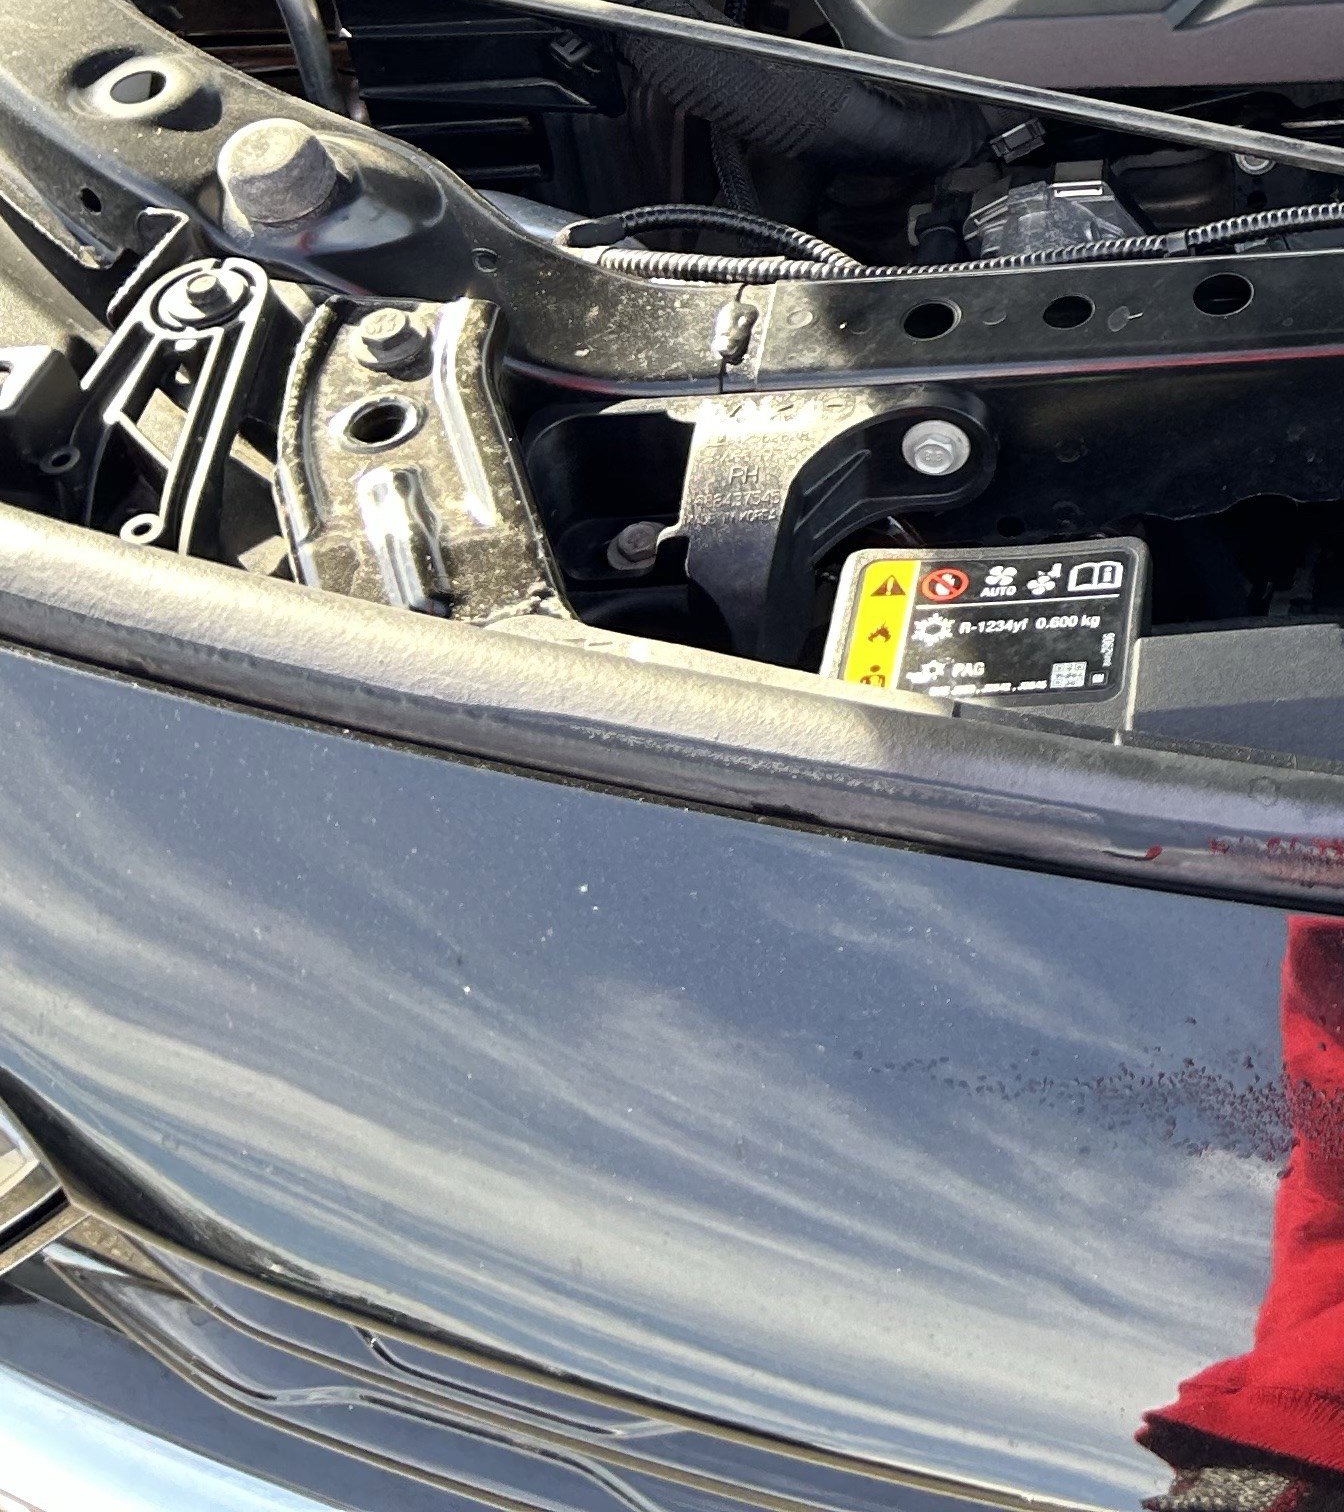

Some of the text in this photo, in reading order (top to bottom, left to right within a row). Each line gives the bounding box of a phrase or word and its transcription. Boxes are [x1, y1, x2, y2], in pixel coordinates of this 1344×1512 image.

[980, 585, 1017, 598] AUTO
[958, 617, 1029, 636] R-1234yf
[1080, 614, 1101, 629] kg
[951, 661, 986, 678] PAG
